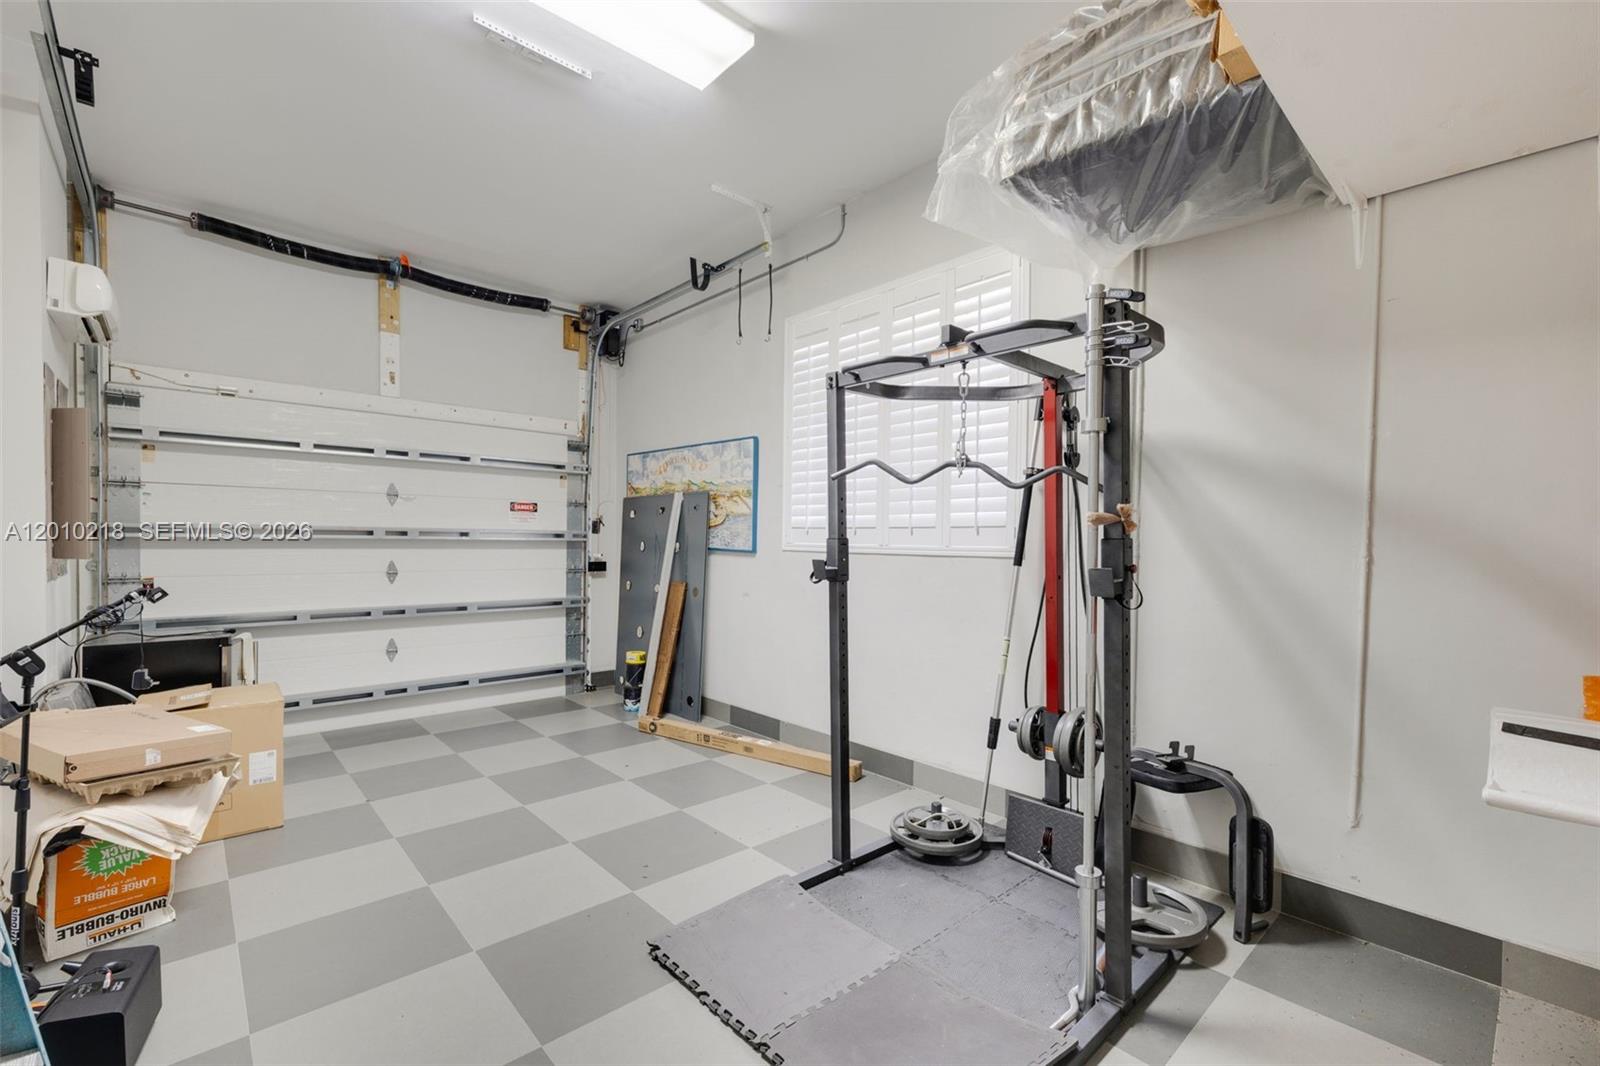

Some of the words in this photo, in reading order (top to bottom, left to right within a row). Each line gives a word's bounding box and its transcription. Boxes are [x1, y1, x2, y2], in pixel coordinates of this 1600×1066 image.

[100, 849, 140, 871] VALUE
[101, 845, 131, 858] ACK
[73, 885, 118, 905] BUBBLE
[121, 876, 157, 894] LARGE
[88, 921, 142, 944] U-HAUL
